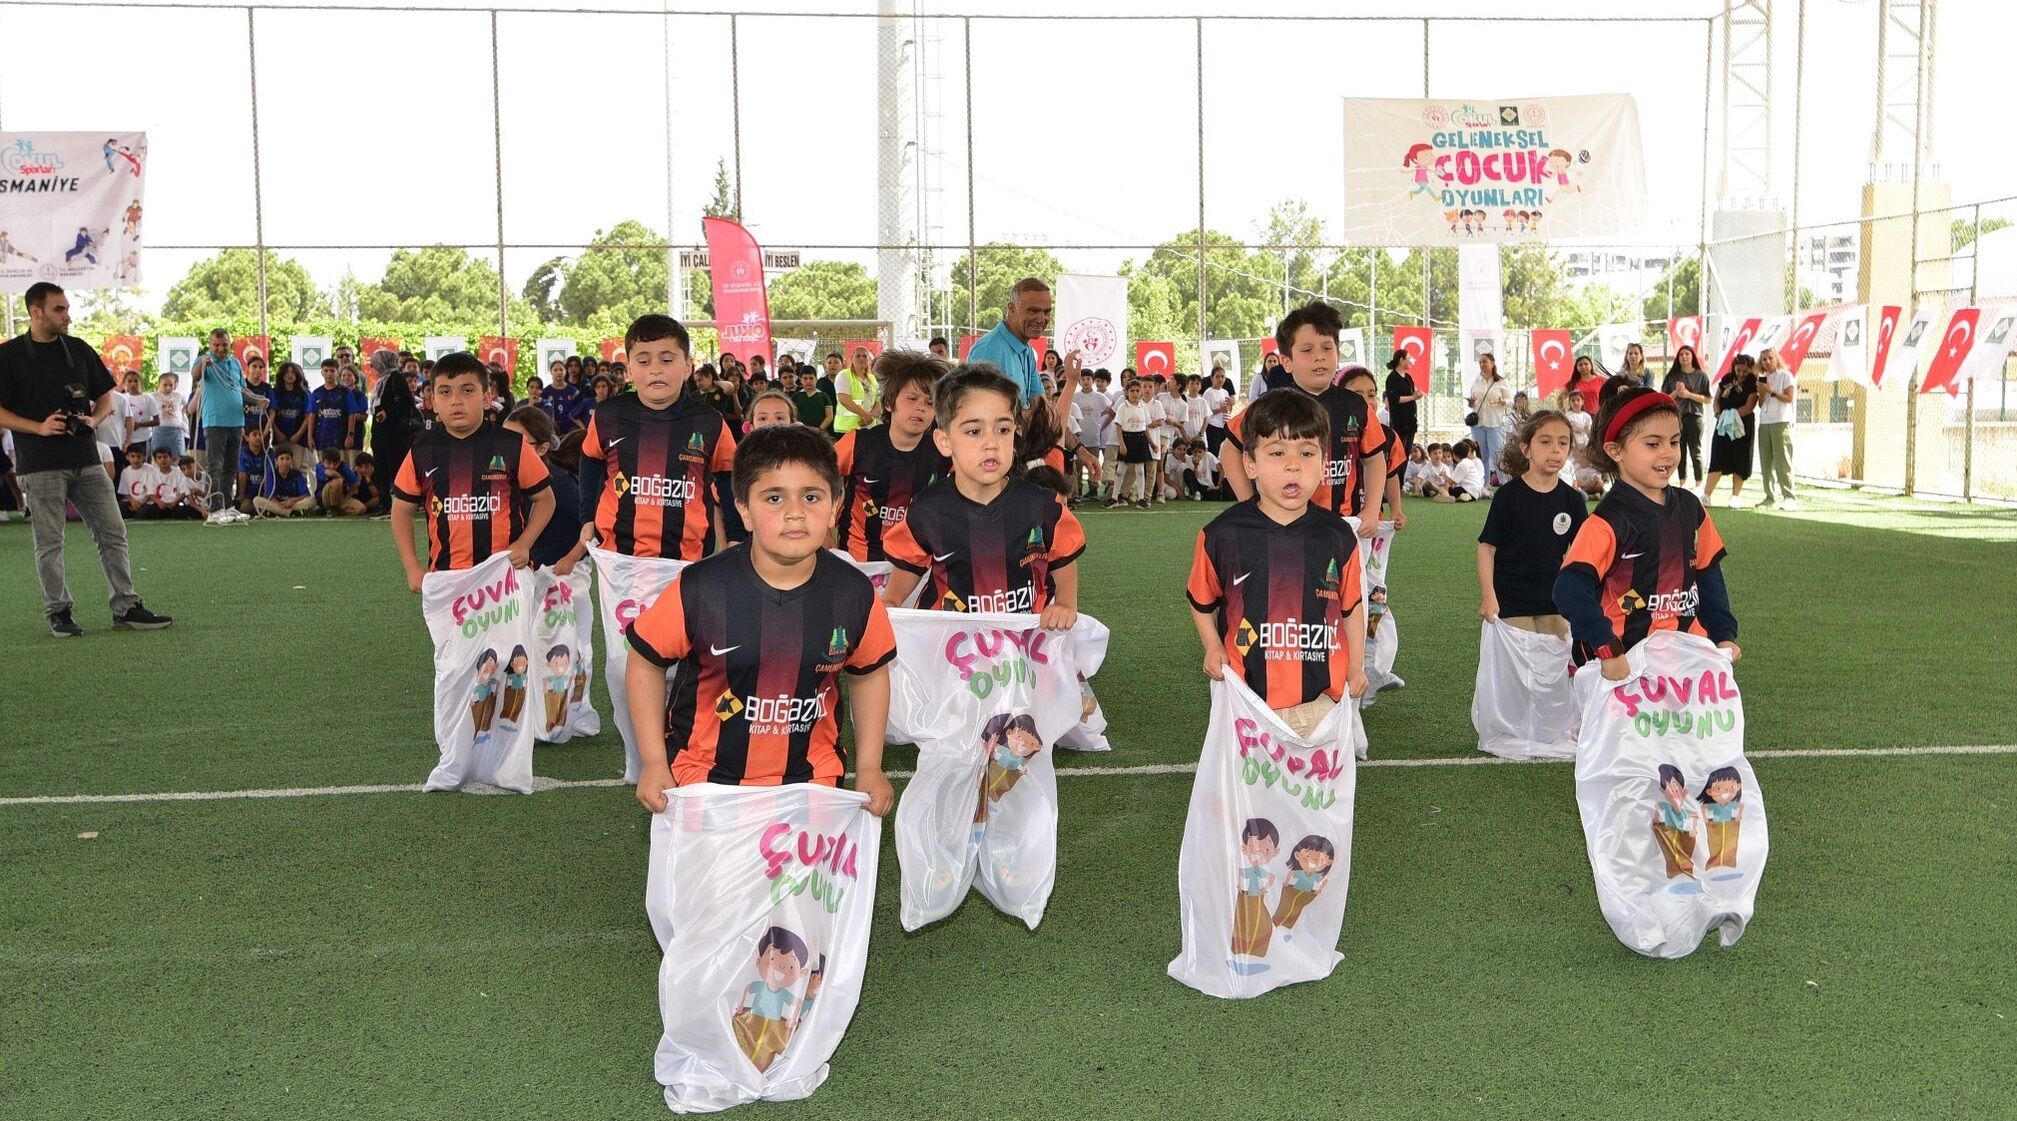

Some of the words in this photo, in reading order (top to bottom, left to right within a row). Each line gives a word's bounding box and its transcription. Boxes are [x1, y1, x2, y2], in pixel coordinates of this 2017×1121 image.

[1431, 129, 1549, 149] GELENEKSEL
[1435, 149, 1549, 187] ÇOCUK
[1441, 187, 1544, 207] OYUNLARI
[775, 254, 799, 268] BESLEN
[1264, 648, 1284, 660] KİTAP
[1285, 650, 1292, 661] &
[1614, 669, 1738, 717] ÇUVAL
[749, 723, 771, 734] KİTAP
[772, 726, 778, 735] &
[1635, 708, 1736, 740] OYUNU
